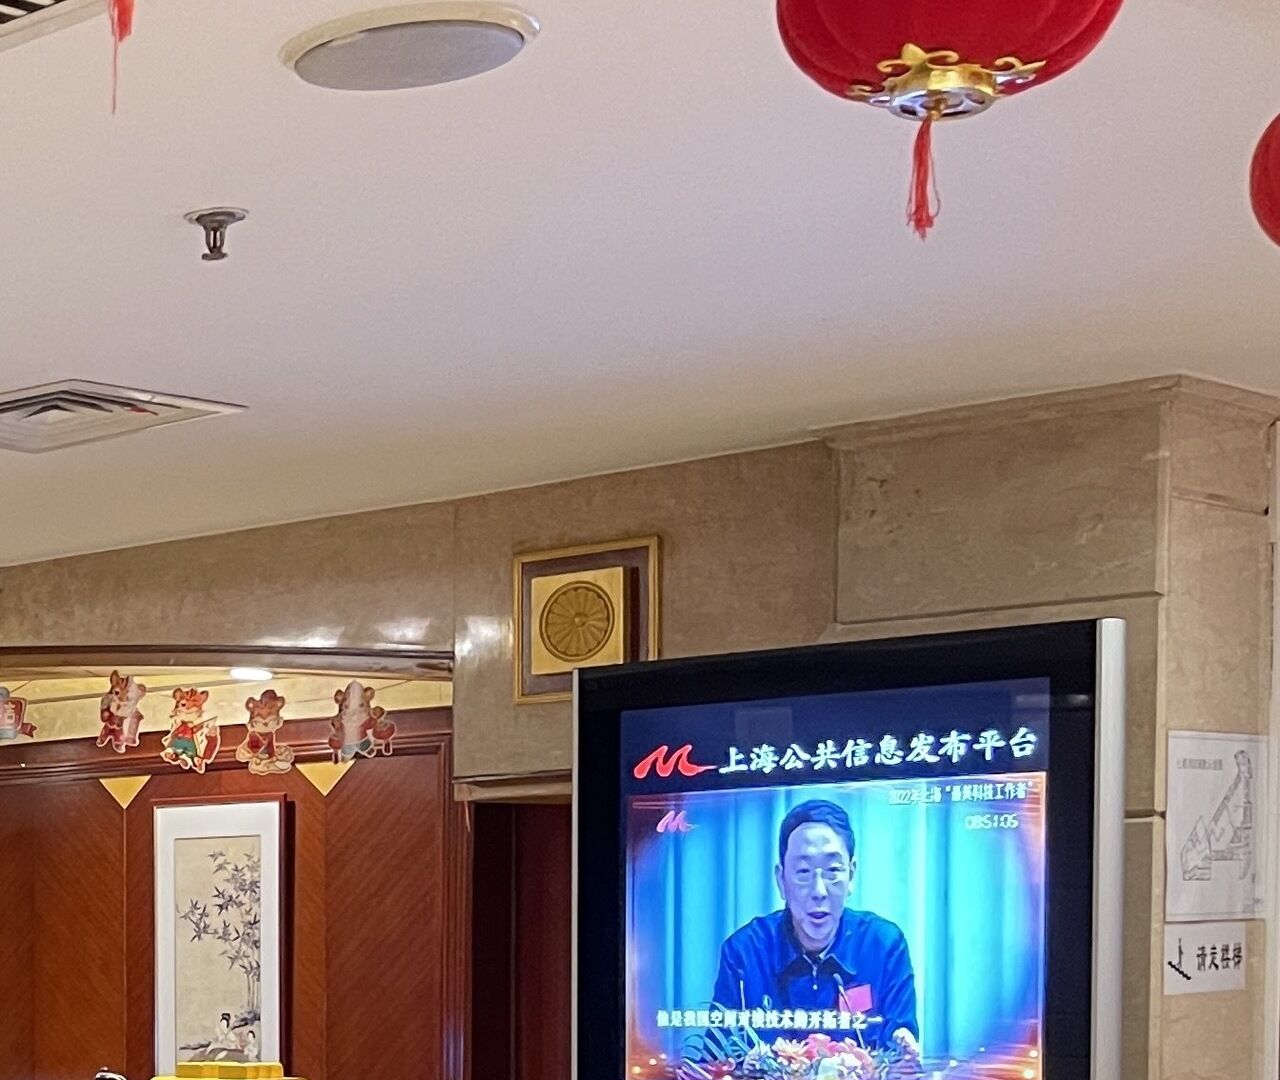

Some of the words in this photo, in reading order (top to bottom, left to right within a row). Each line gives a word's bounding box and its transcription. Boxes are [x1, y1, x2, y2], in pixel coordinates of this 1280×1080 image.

[719, 727, 1039, 774] 上海公共信息发布平台
[1197, 943, 1243, 971] 请走楼梯
